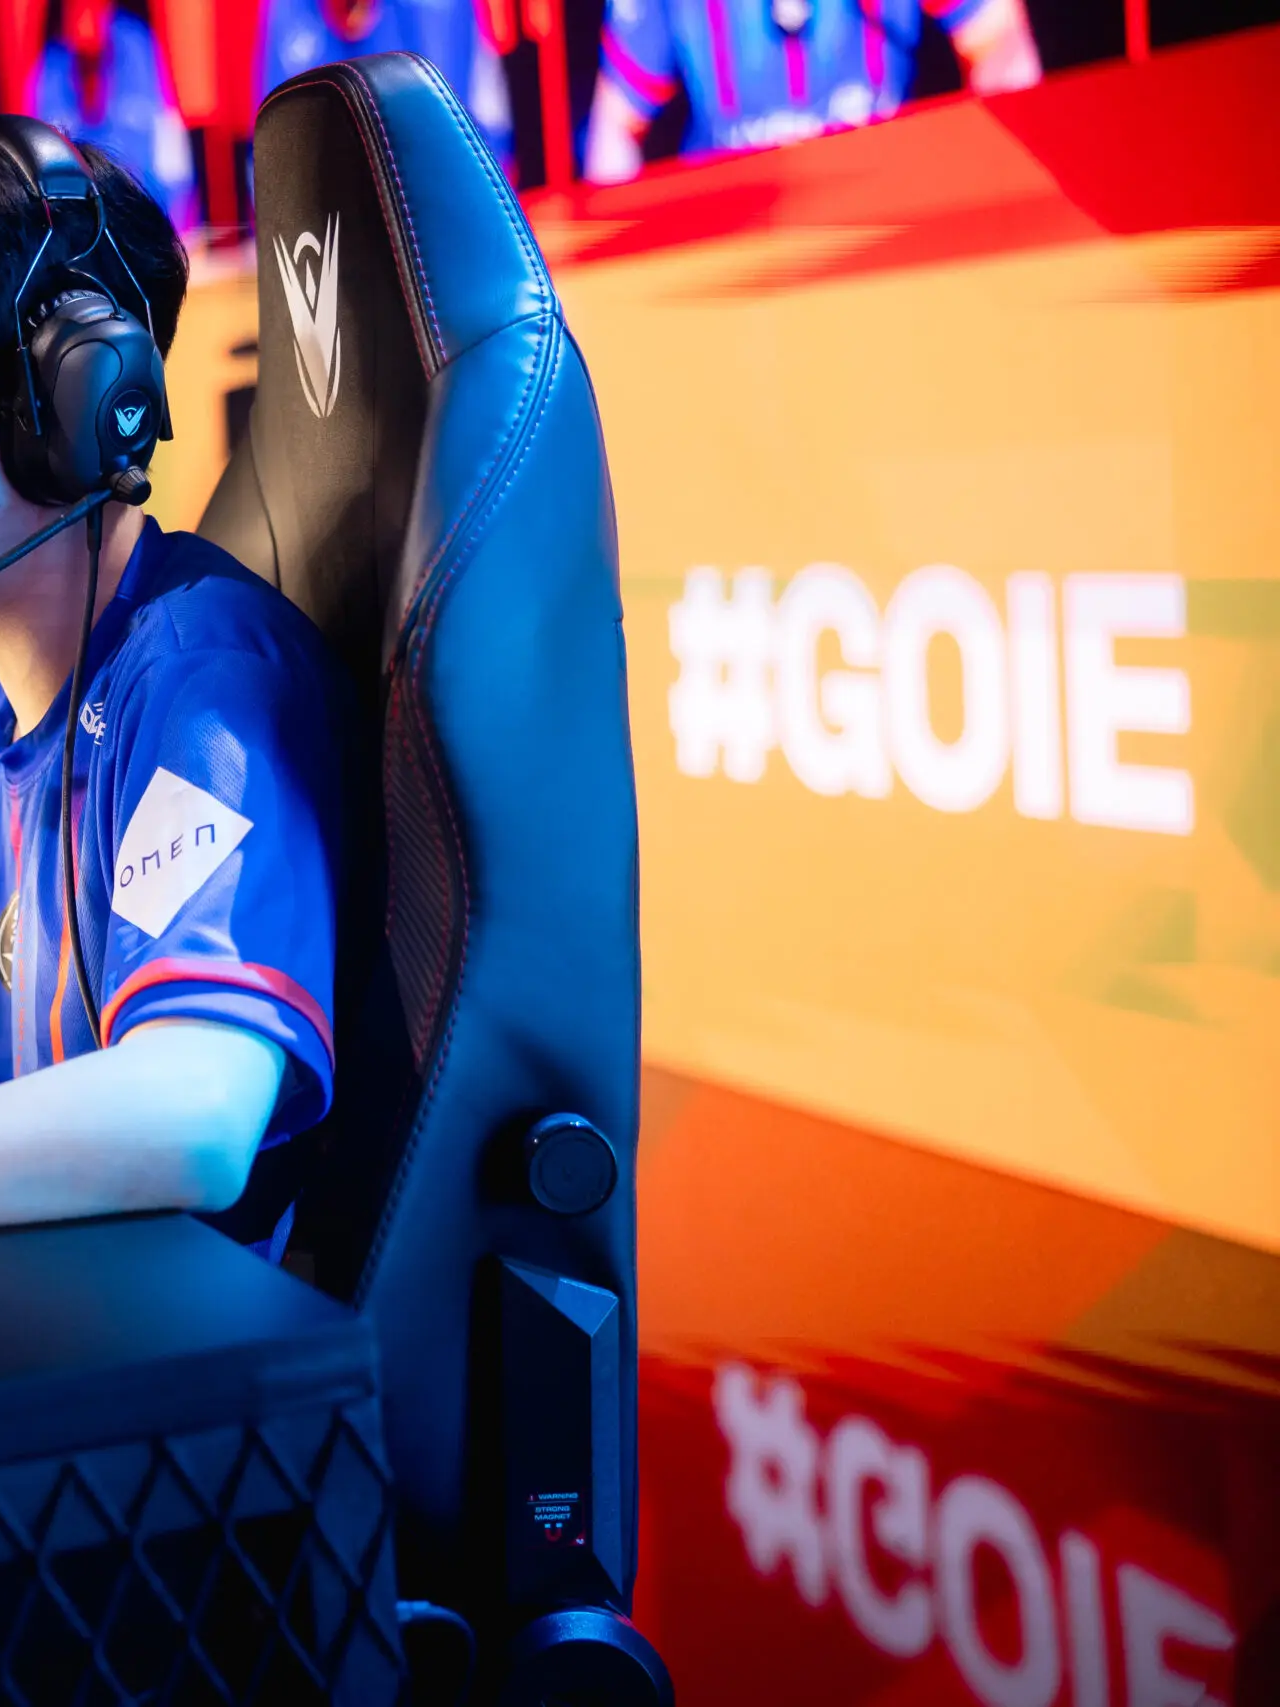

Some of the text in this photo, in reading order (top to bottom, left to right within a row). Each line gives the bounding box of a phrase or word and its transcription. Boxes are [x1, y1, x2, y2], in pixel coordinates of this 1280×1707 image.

[668, 561, 1195, 836] #GOIE
[119, 823, 216, 888] OMEN
[538, 1492, 579, 1500] WARNING
[534, 1505, 571, 1513] STRONG
[534, 1513, 572, 1521] MAGNET
